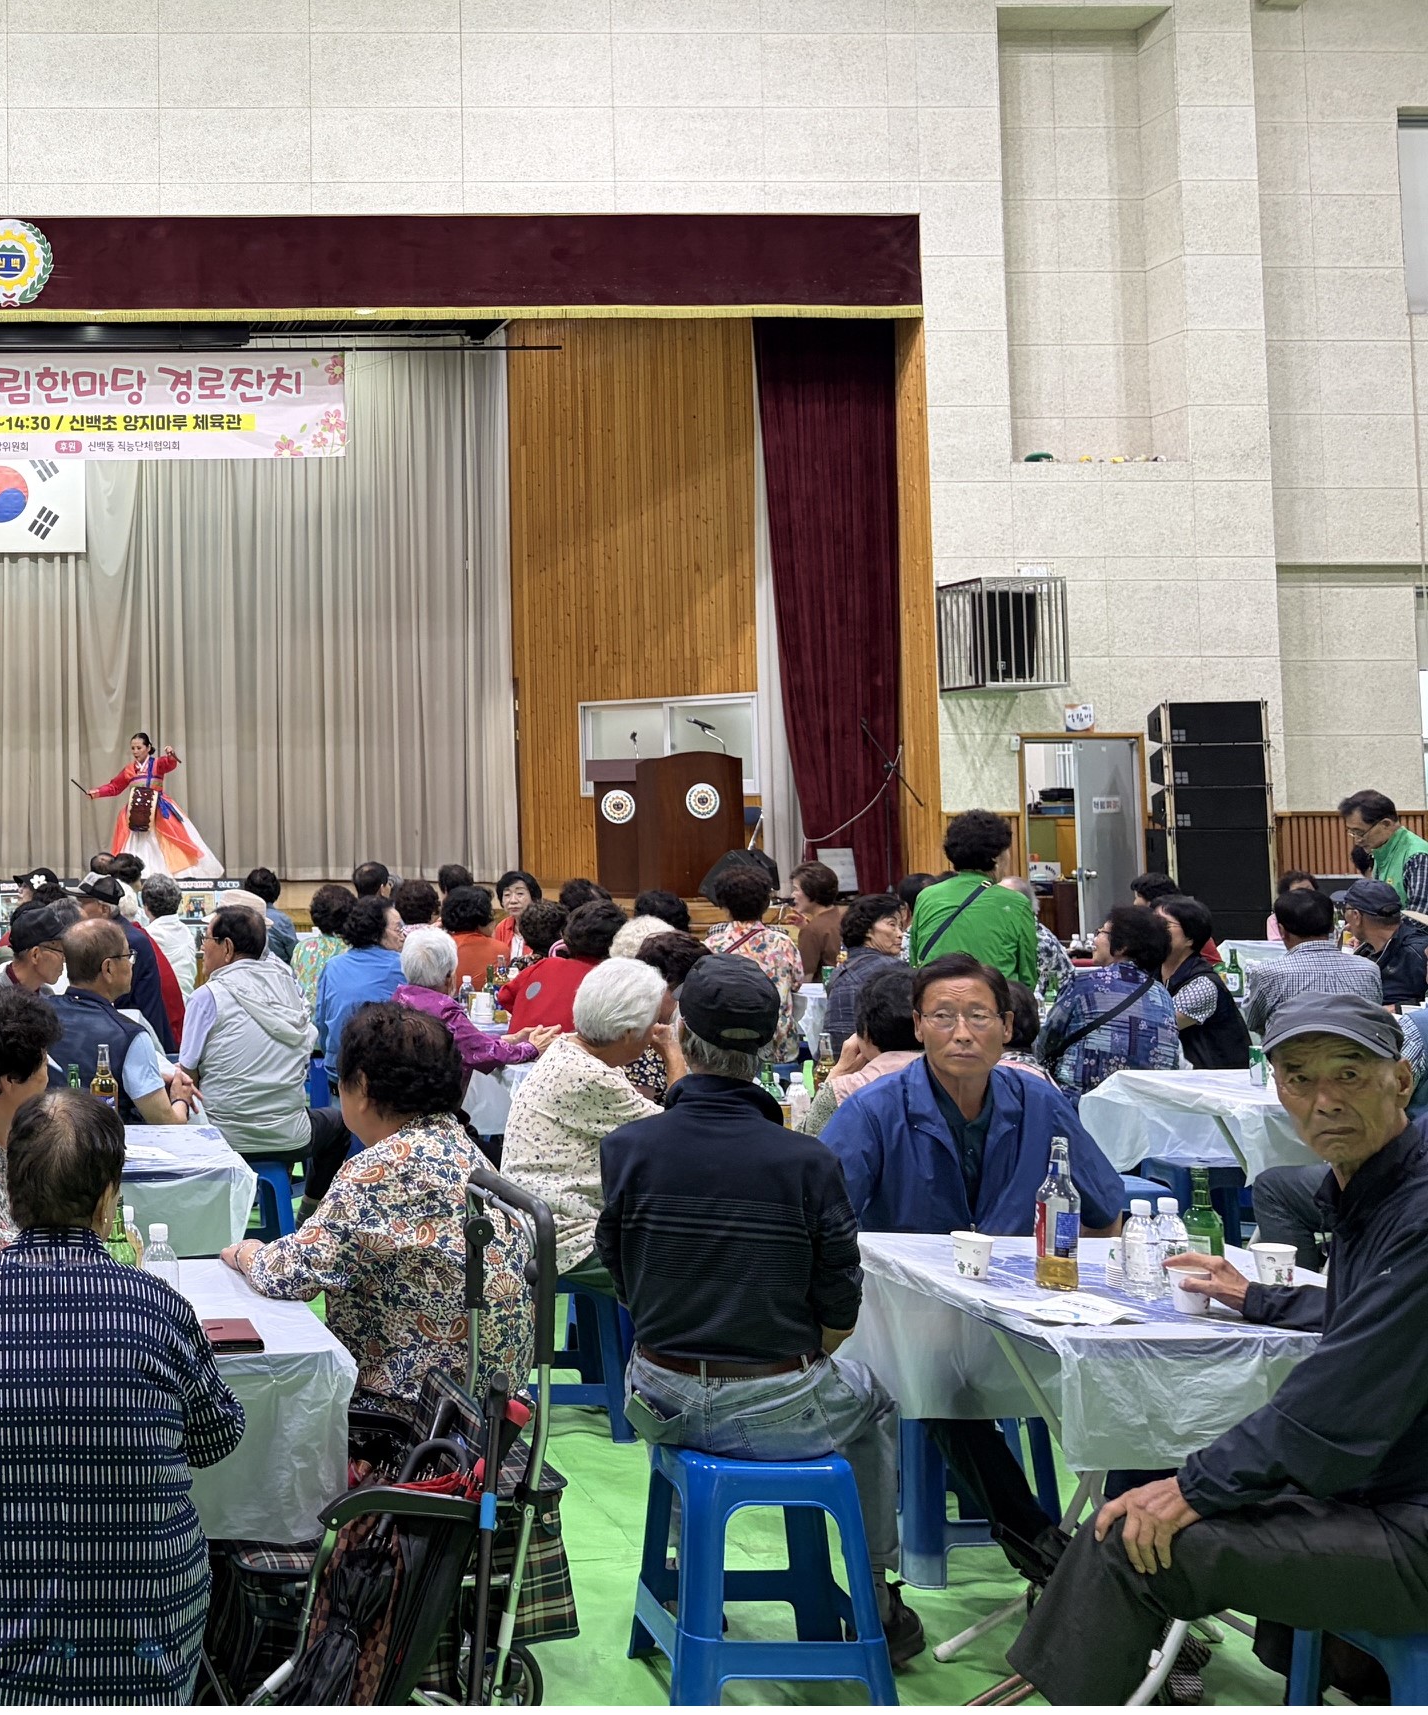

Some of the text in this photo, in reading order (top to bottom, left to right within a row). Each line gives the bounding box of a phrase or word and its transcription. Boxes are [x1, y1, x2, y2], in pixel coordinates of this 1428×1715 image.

[157, 367, 302, 405] 경로잔치
[55, 415, 64, 431] /
[68, 415, 118, 432] 신백초
[123, 415, 188, 432] 양지마루
[192, 414, 242, 431] 체육관
[59, 442, 77, 453] 후원
[87, 441, 115, 452] 신백동
